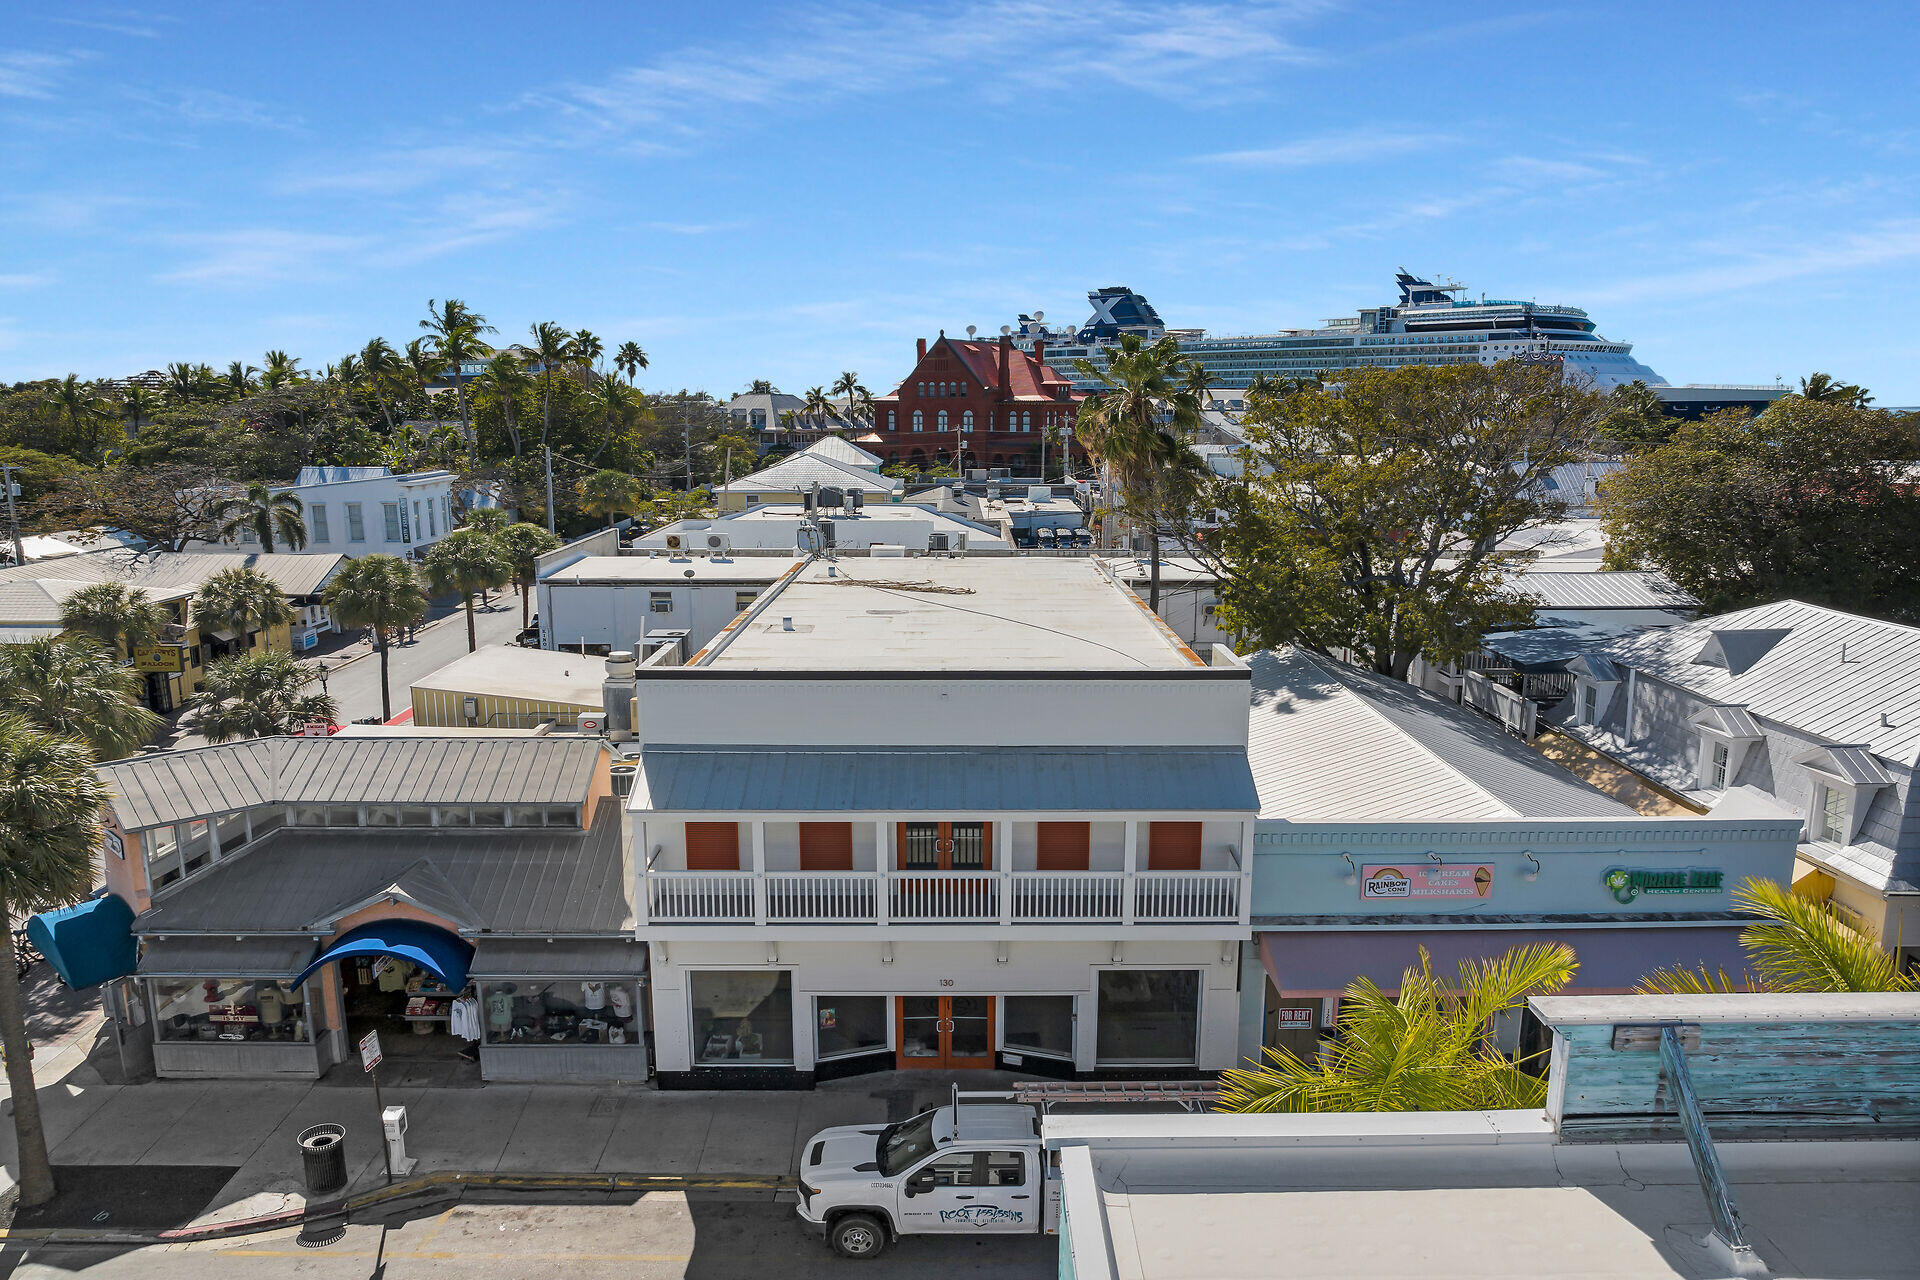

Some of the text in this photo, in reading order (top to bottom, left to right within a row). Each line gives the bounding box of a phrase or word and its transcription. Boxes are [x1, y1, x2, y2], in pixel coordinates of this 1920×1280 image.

[1368, 881, 1408, 894] RAINBOW
[940, 979, 954, 987] 130
[1281, 1010, 1310, 1020] FOR RENT
[939, 1206, 1023, 1223] ROOF ASSASSINS
